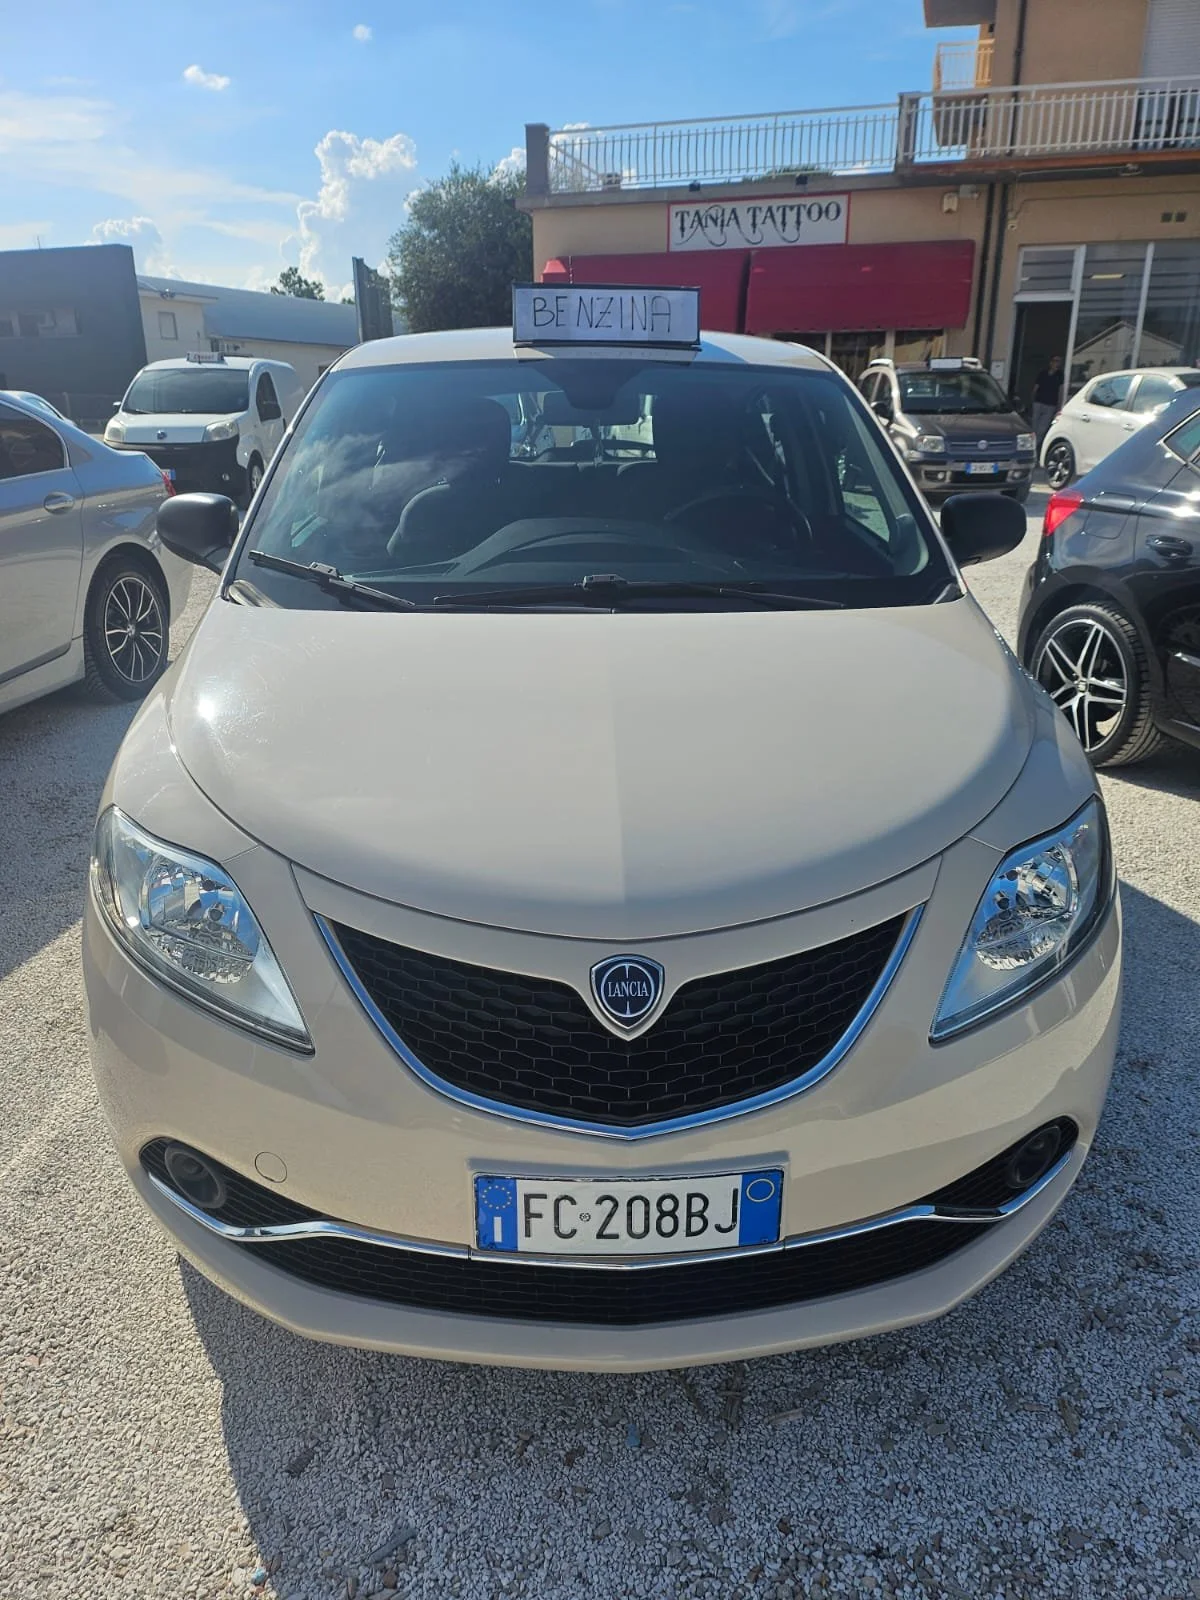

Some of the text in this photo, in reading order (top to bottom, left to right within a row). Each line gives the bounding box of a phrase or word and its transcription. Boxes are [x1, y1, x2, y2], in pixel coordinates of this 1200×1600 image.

[674, 201, 841, 247] TANIA TATTOO
[532, 295, 672, 333] BENZINA
[607, 981, 650, 997] LANCIA
